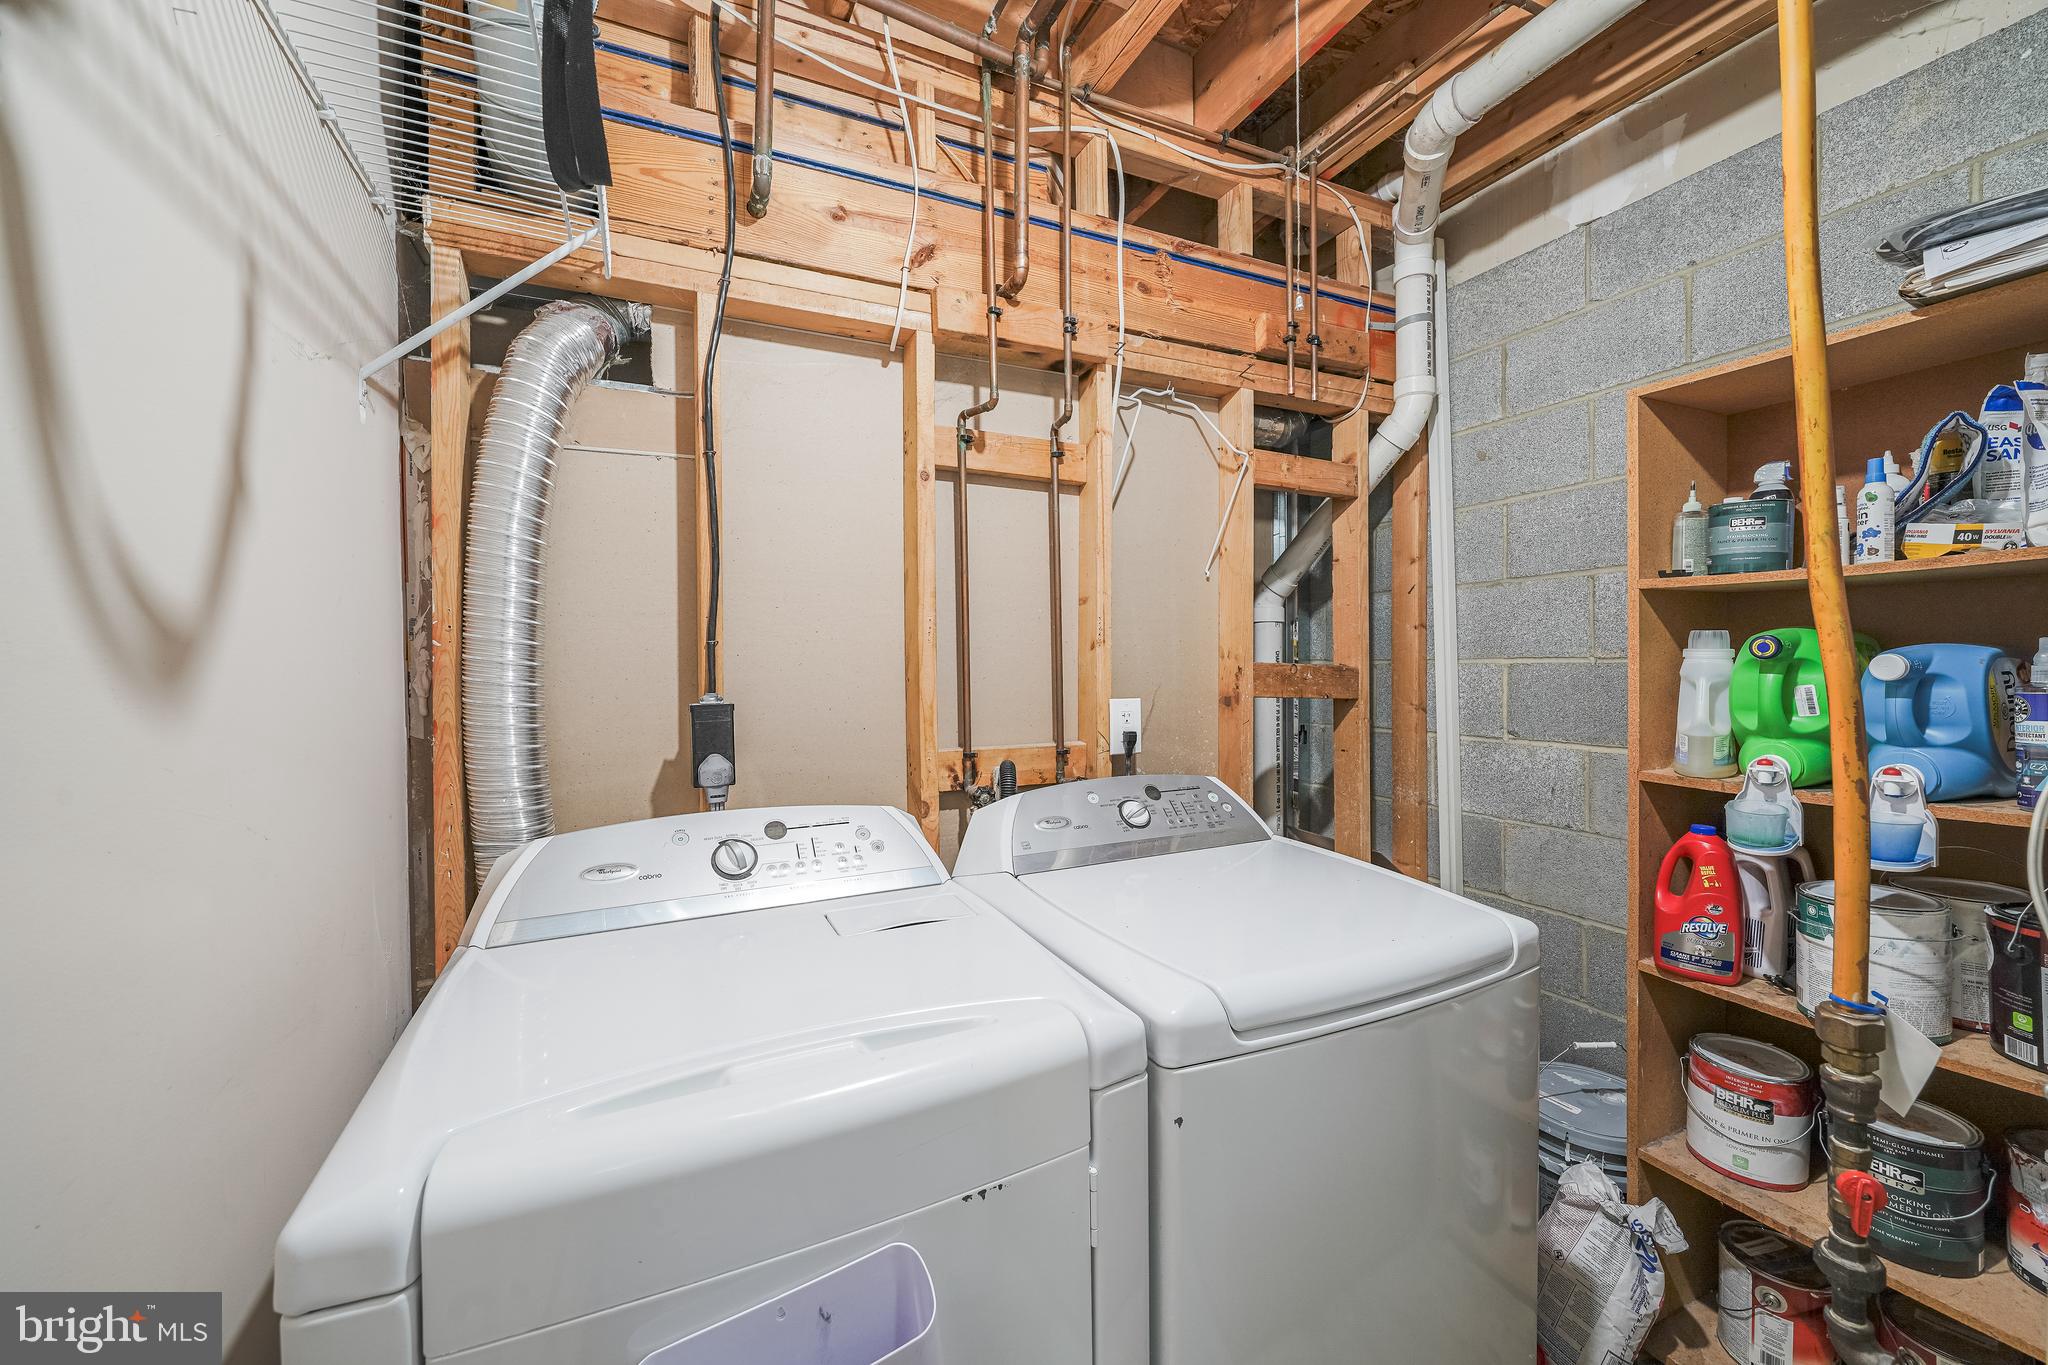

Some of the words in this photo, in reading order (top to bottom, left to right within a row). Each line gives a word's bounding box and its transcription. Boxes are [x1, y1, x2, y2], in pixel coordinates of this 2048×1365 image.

[1731, 518, 1755, 526] BEHR
[638, 872, 662, 880] cabrio
[1682, 923, 1728, 934] RESOLVE
[1726, 1075, 1750, 1086] INTERIOR
[1716, 1087, 1754, 1110] BEHR
[1727, 1126, 1760, 1140] PRIMER
[1727, 1143, 1739, 1151] LOW
[1740, 1148, 1757, 1156] ODOR
[1872, 1136, 1914, 1153] SEMI-GLOSS
[1916, 1149, 1945, 1159] ENAMEL
[1916, 1208, 1929, 1218] IN
